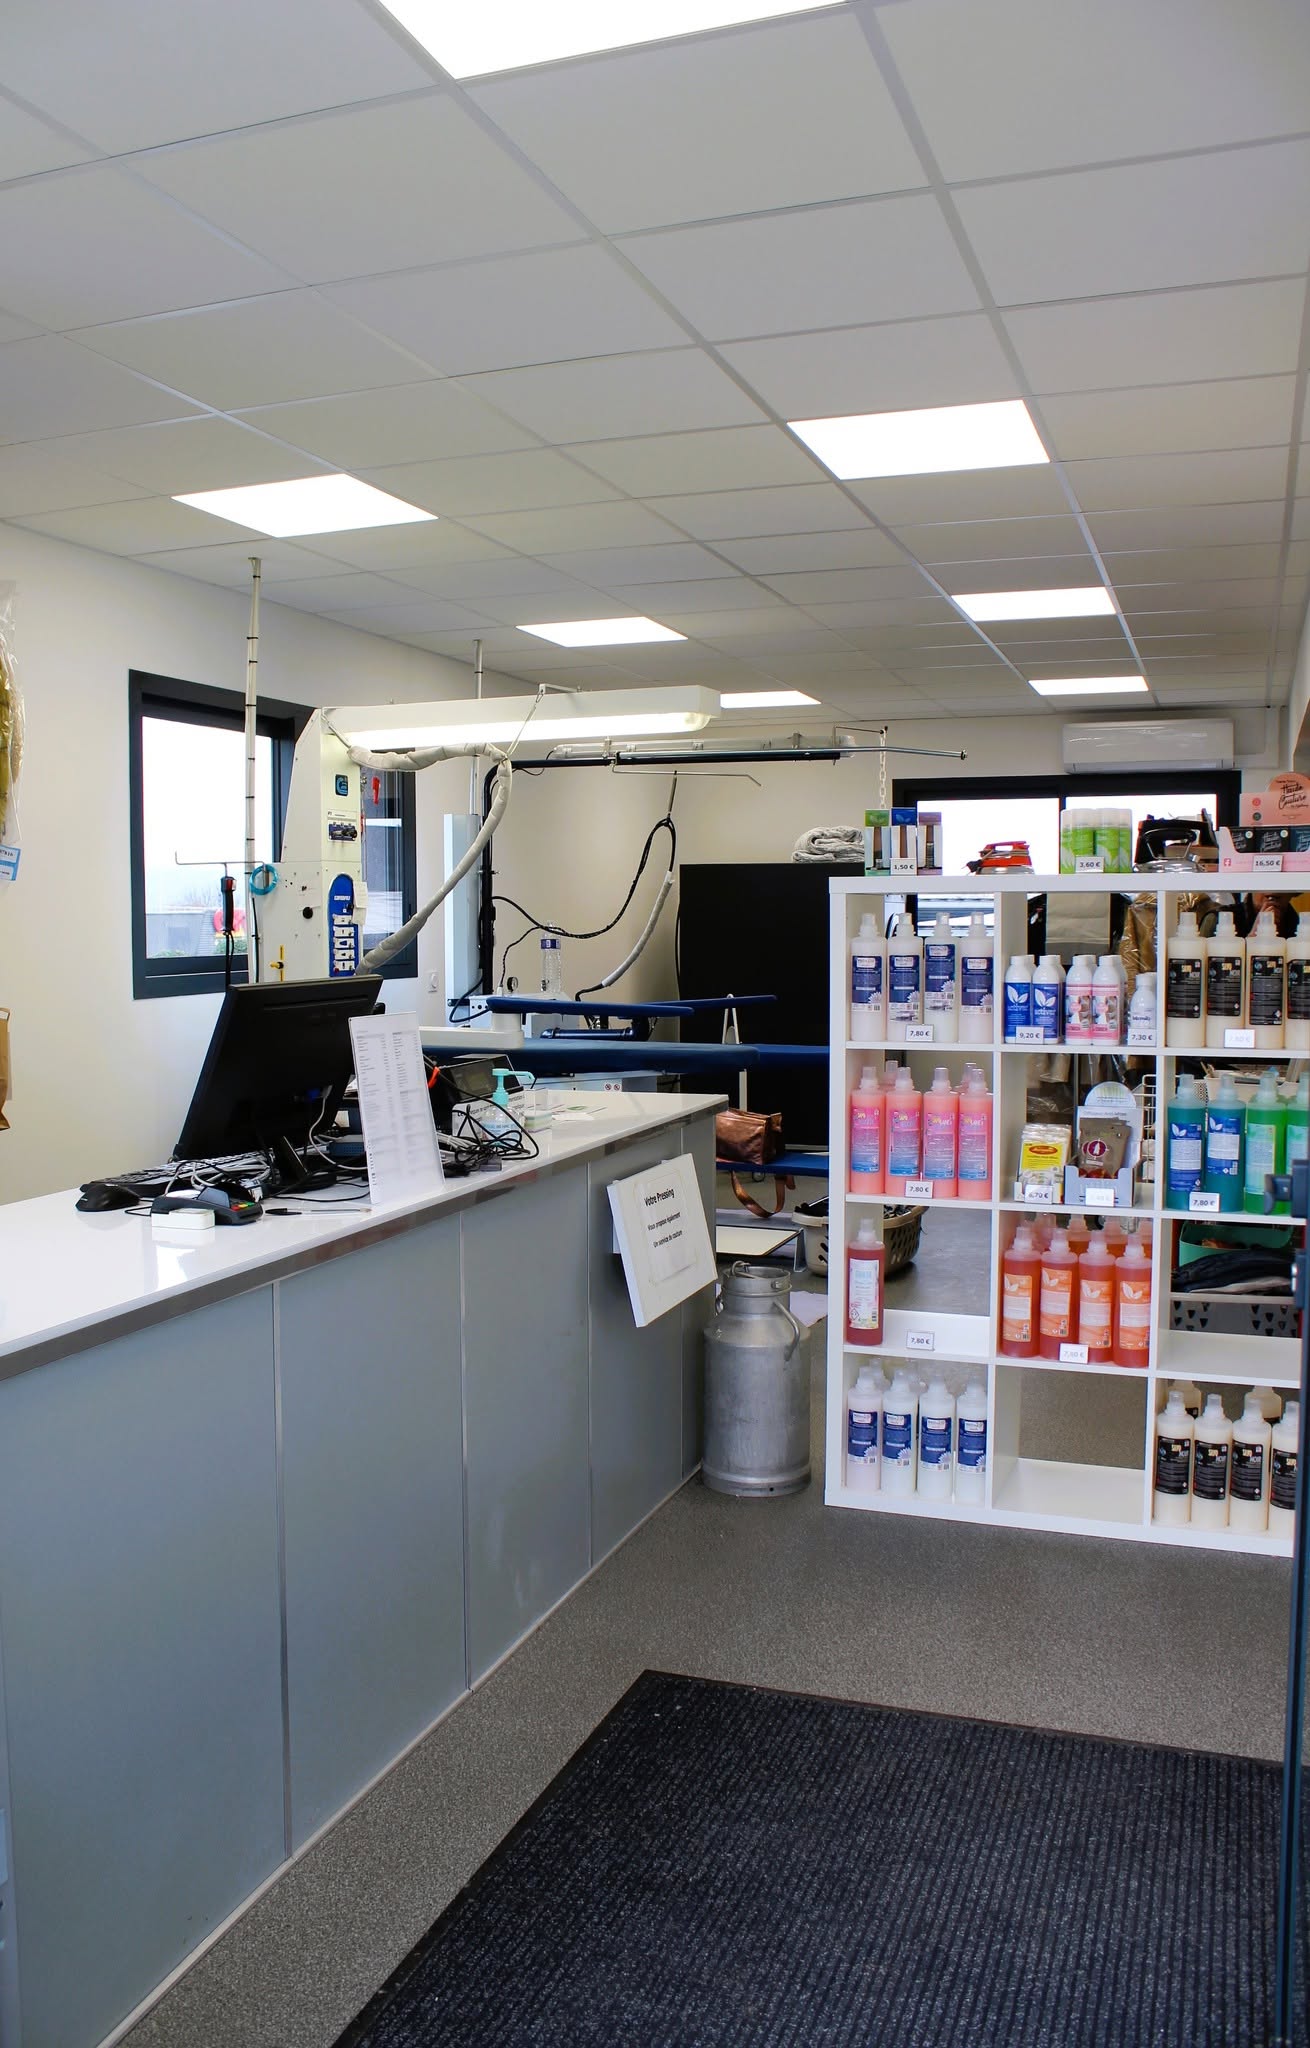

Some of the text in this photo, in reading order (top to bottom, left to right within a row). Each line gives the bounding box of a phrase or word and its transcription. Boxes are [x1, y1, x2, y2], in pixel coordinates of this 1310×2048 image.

[910, 1030, 924, 1038] 7,80
[1019, 1032, 1034, 1040] 9,20
[910, 1186, 924, 1194] 7,80
[644, 1188, 674, 1206] Votre Pressing
[1193, 1199, 1208, 1208] 7,80
[910, 1336, 925, 1345] 7,80
